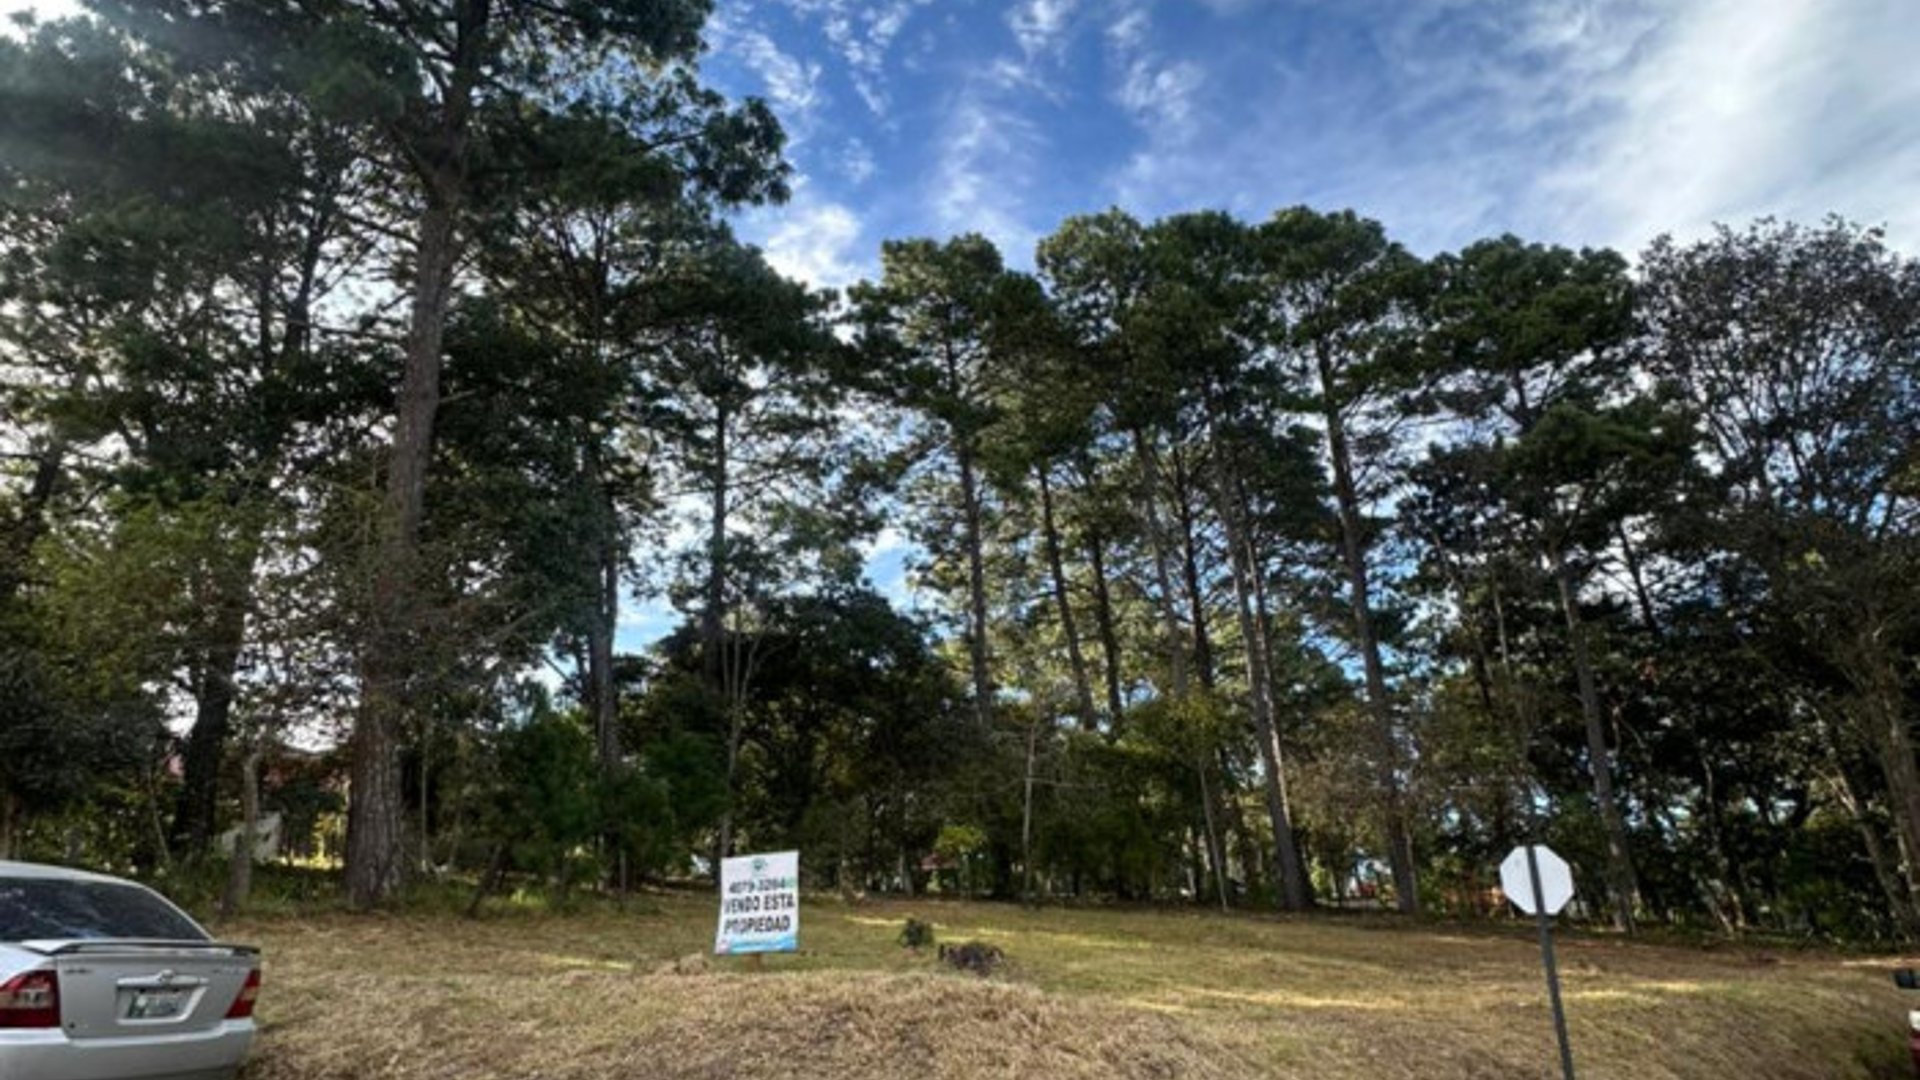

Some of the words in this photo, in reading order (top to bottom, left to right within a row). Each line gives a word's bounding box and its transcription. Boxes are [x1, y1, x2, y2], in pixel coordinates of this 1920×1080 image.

[724, 895, 761, 914] VENDO
[764, 893, 795, 911] ESTA
[724, 915, 791, 935] PROPIEDAD
